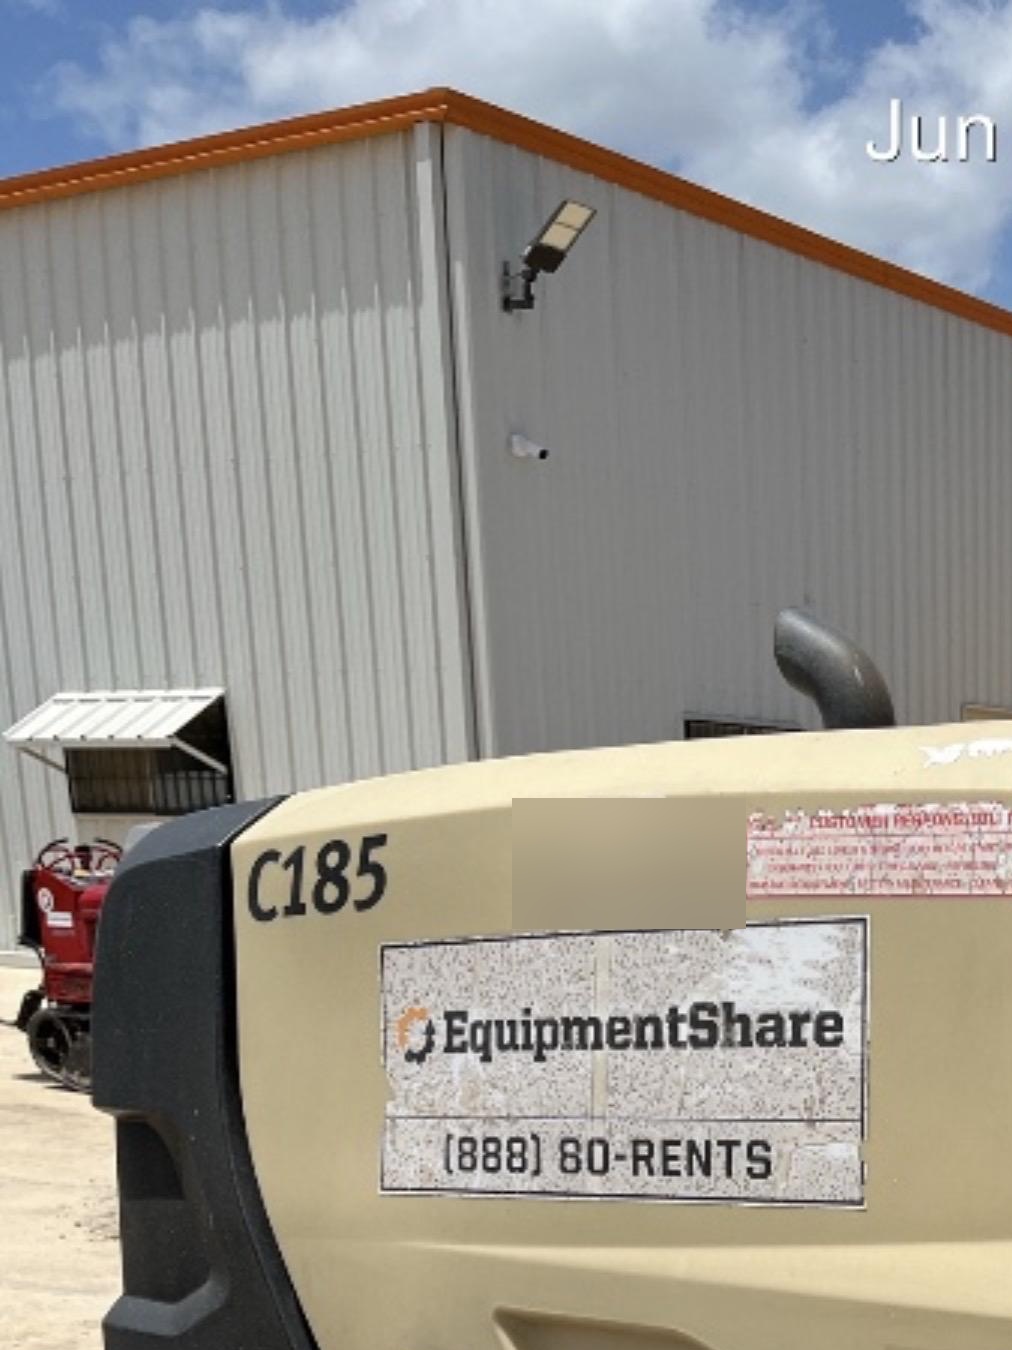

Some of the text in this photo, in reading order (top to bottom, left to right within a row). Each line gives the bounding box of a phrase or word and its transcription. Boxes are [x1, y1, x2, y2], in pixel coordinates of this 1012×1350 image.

[248, 833, 388, 922] C185
[443, 1001, 844, 1062] EquipmentShare
[444, 1133, 772, 1179] (888) 80-RENTS
